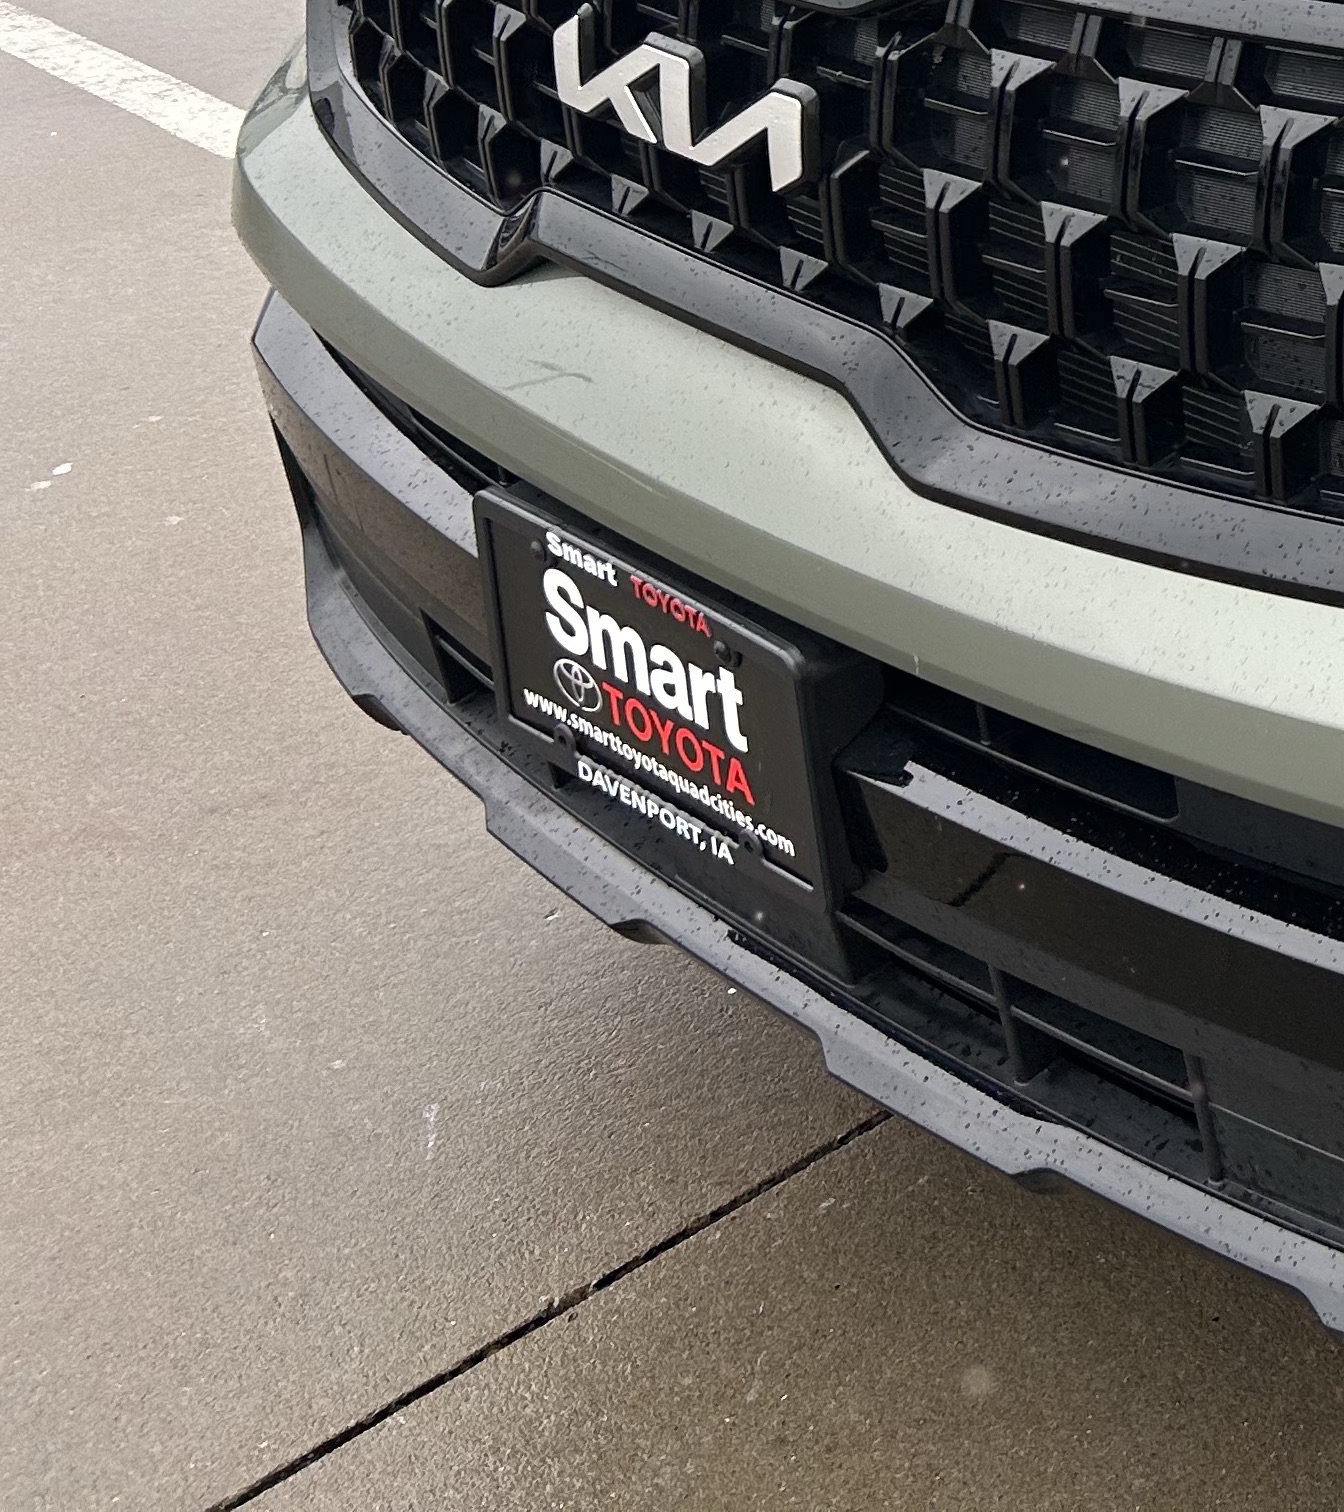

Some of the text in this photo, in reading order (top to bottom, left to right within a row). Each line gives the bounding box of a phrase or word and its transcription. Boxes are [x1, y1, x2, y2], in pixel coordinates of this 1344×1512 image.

[545, 531, 711, 638] Smart TOYOTA
[543, 568, 748, 753] Smart
[523, 688, 795, 857] www.smarttoyotaquadcities.com
[602, 681, 755, 806] TOYOTA
[577, 759, 735, 865] DAVENPORT, IA
